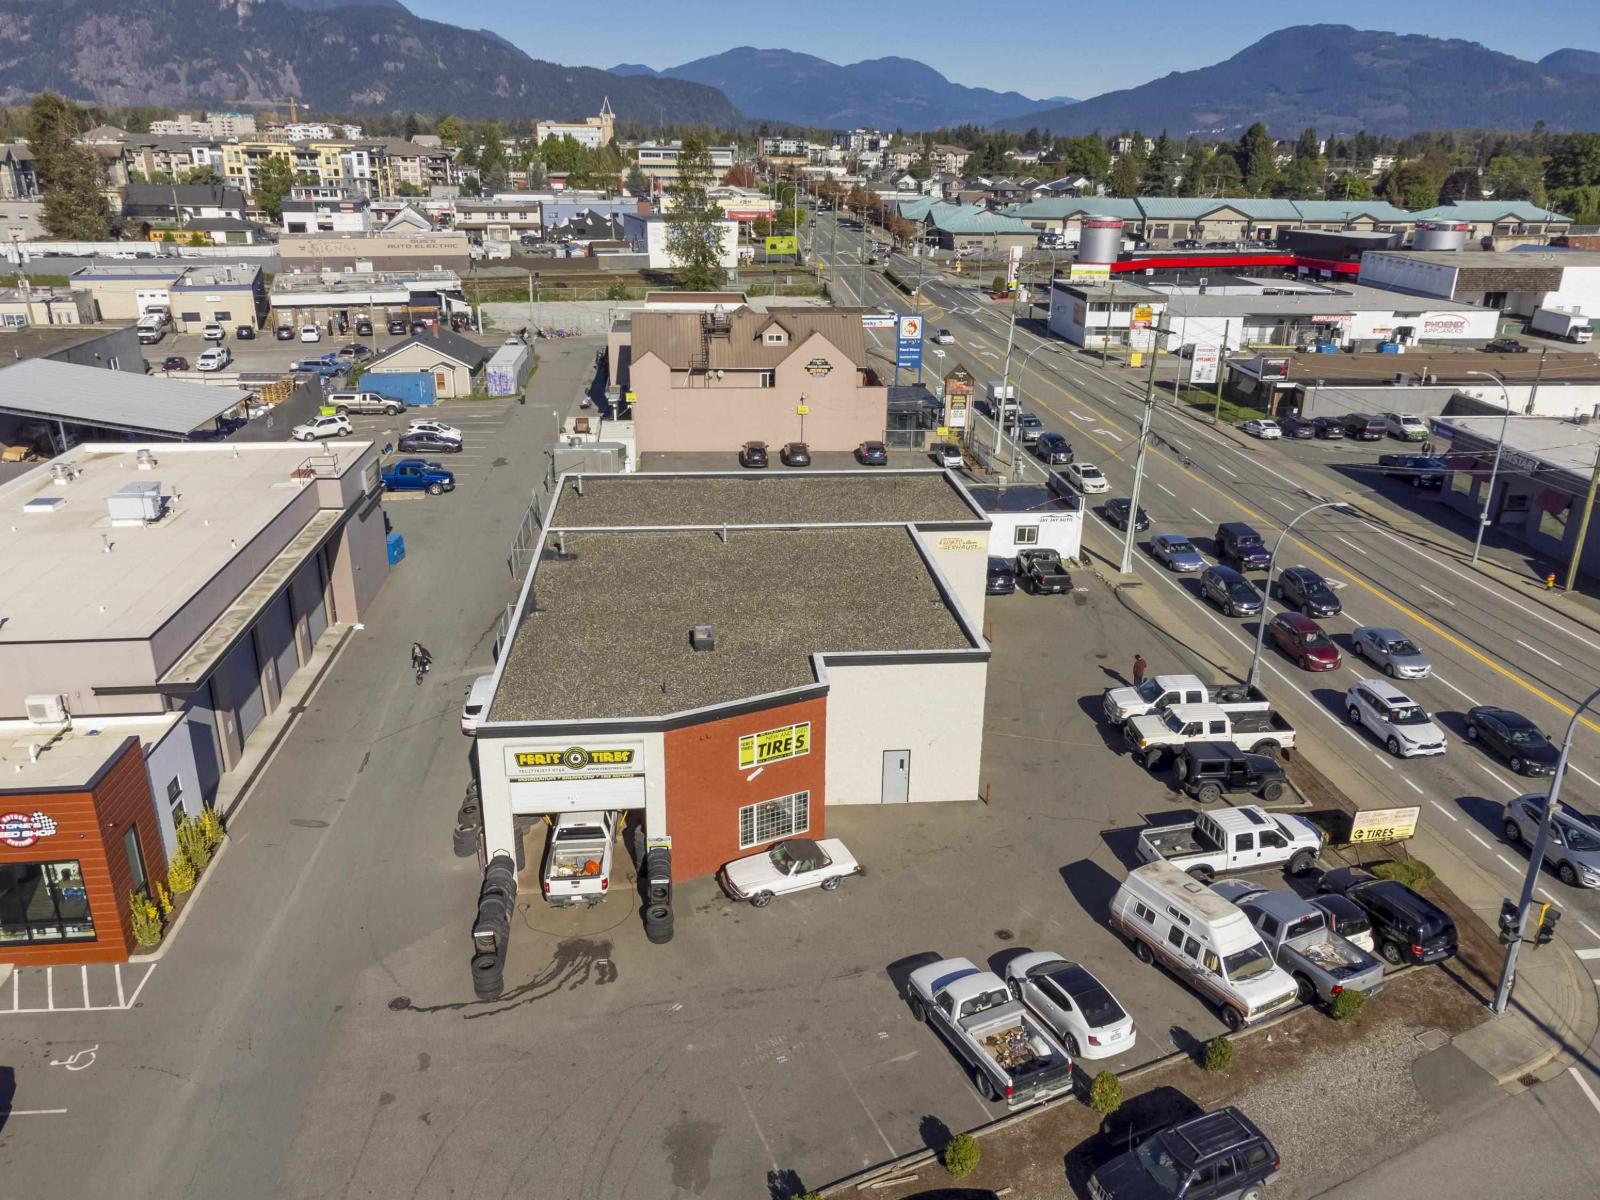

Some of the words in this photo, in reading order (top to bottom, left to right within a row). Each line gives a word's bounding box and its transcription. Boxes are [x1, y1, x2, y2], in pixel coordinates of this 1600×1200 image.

[1424, 321, 1466, 329] PHOENIX
[758, 734, 805, 758] TIRES
[519, 752, 561, 766] FERI'S
[591, 751, 630, 763] TIRES
[1366, 828, 1395, 838] TIRES
